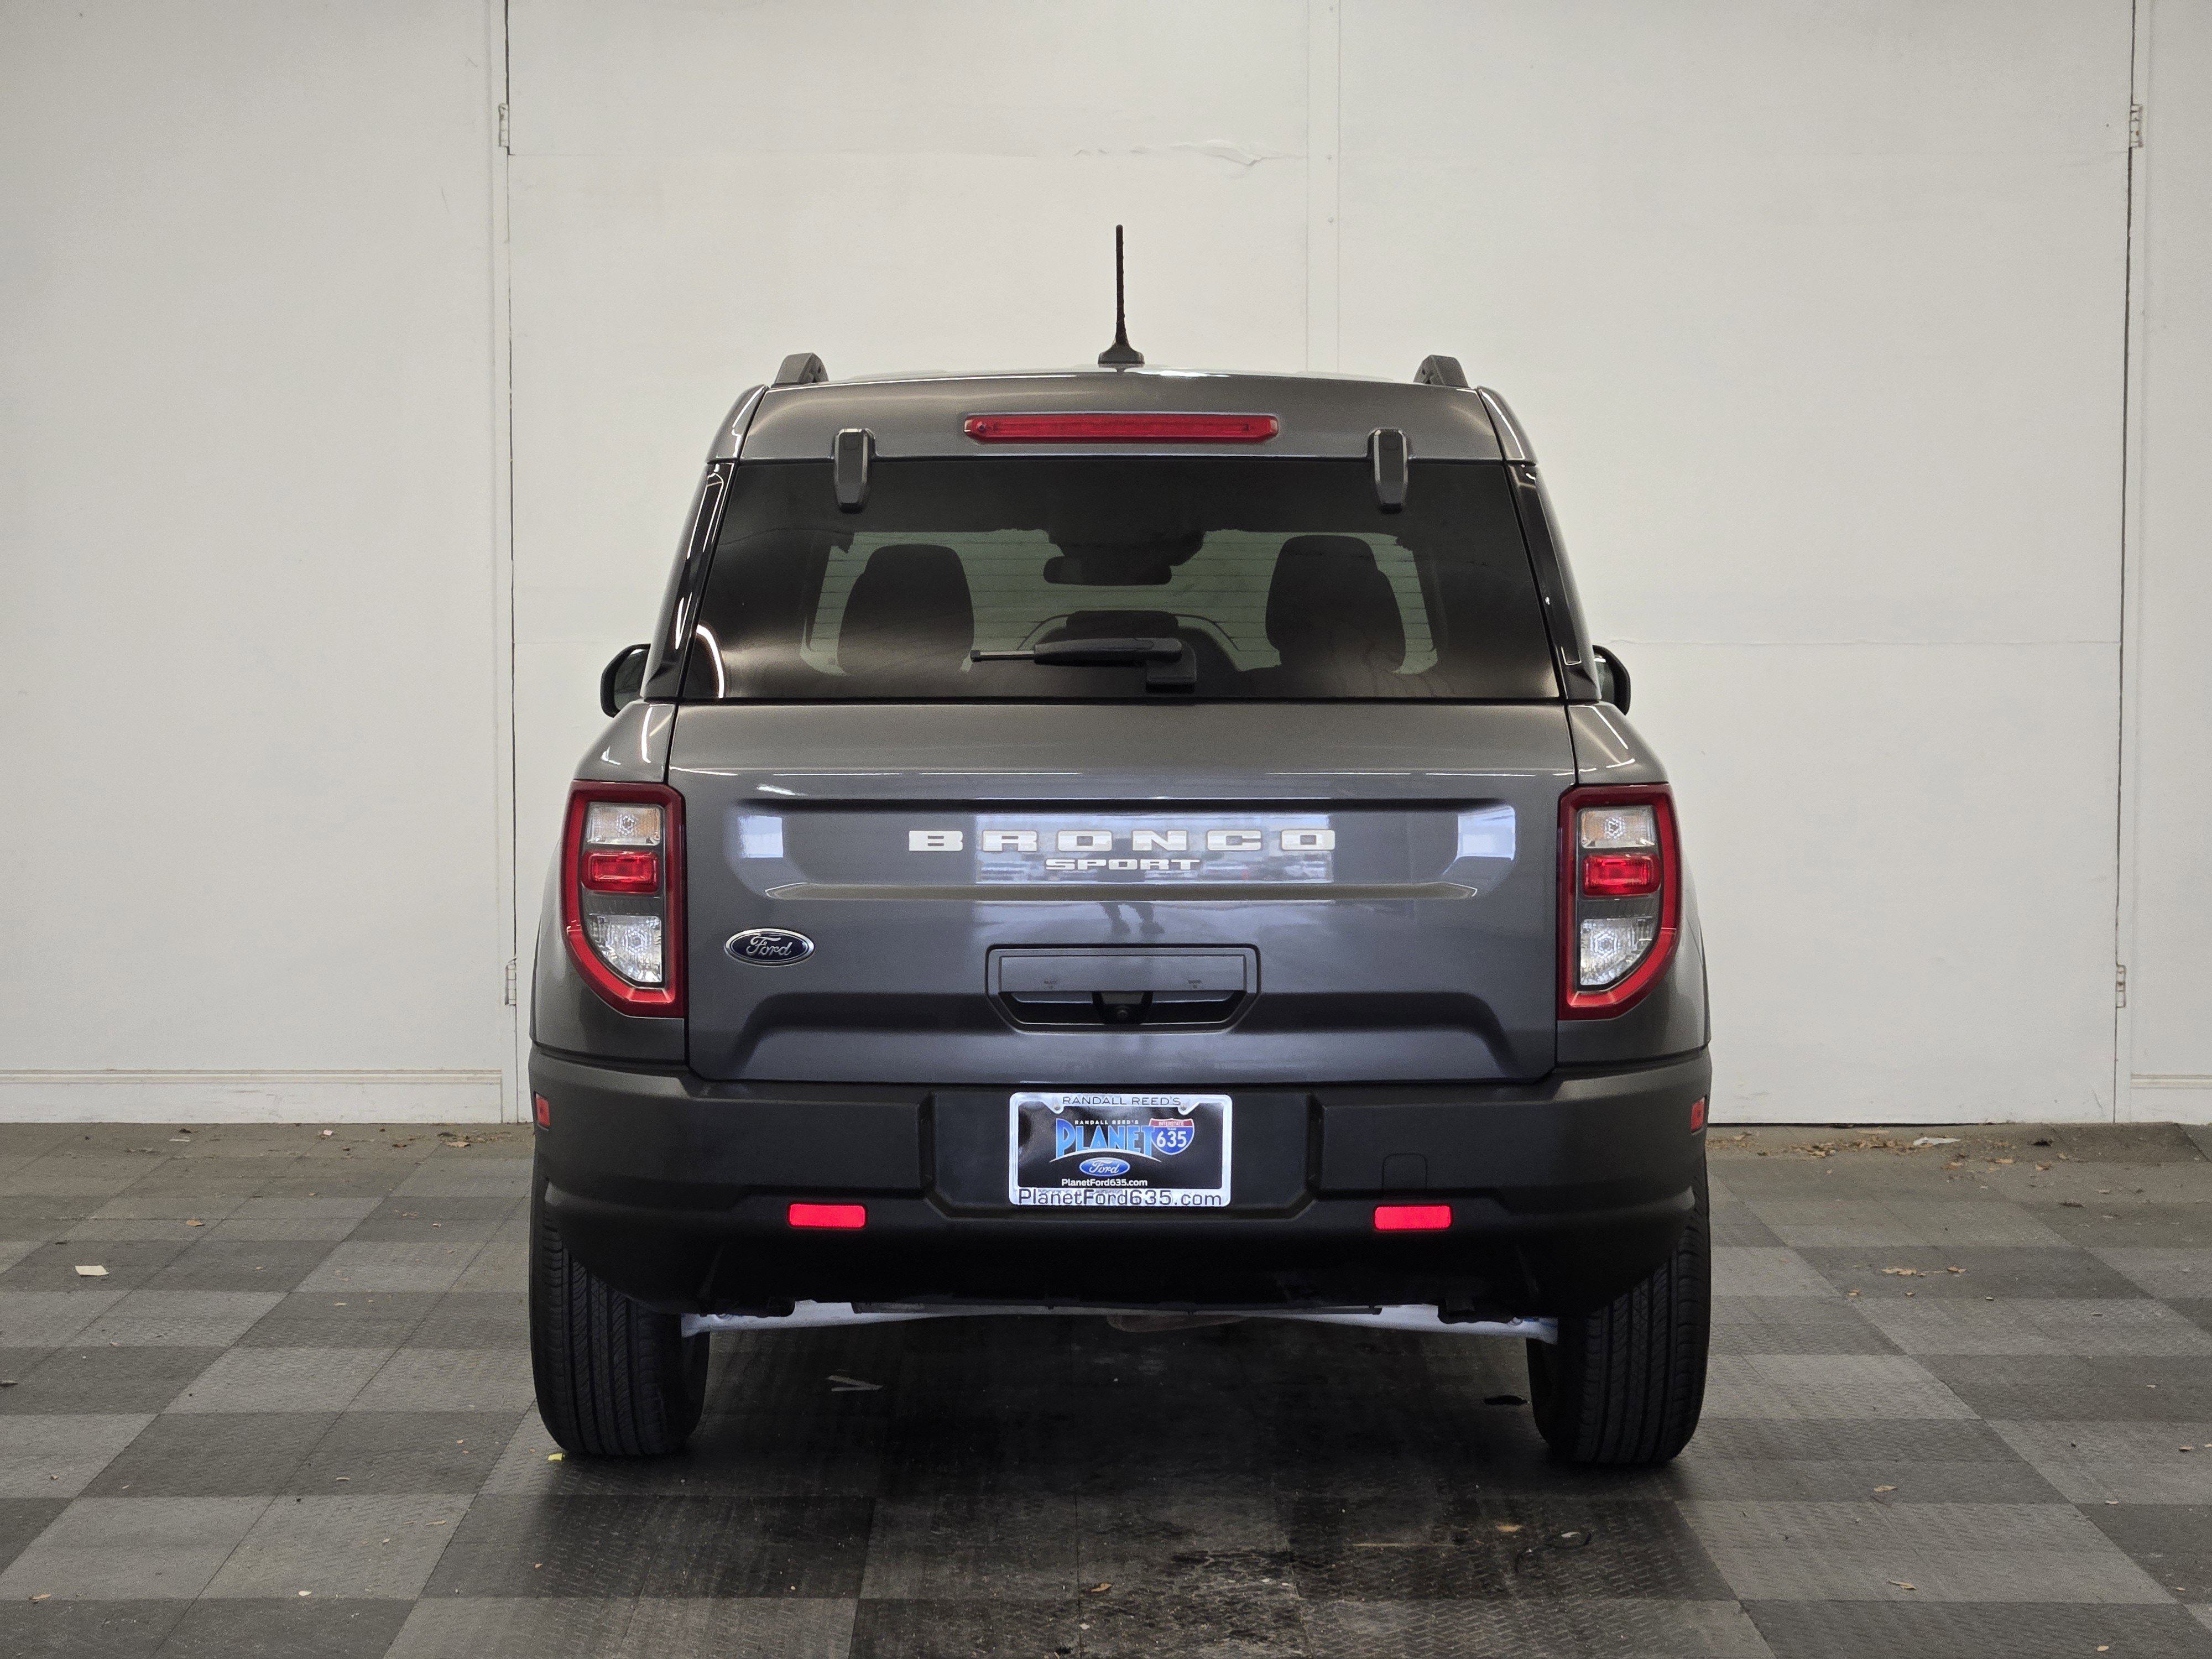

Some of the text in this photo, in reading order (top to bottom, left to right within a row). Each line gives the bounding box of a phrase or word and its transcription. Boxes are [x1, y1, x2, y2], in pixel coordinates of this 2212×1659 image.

[908, 829, 1336, 851] BRONCO
[1045, 859, 1200, 870] SPORT
[746, 936, 793, 956] Ford
[1062, 1097, 1181, 1106] RANDALL REED'S
[1056, 1118, 1155, 1159] PLANET
[1156, 1131, 1187, 1147] 635
[1089, 1161, 1120, 1175] Ford
[1018, 1188, 1222, 1206] PlanetFord635.com
